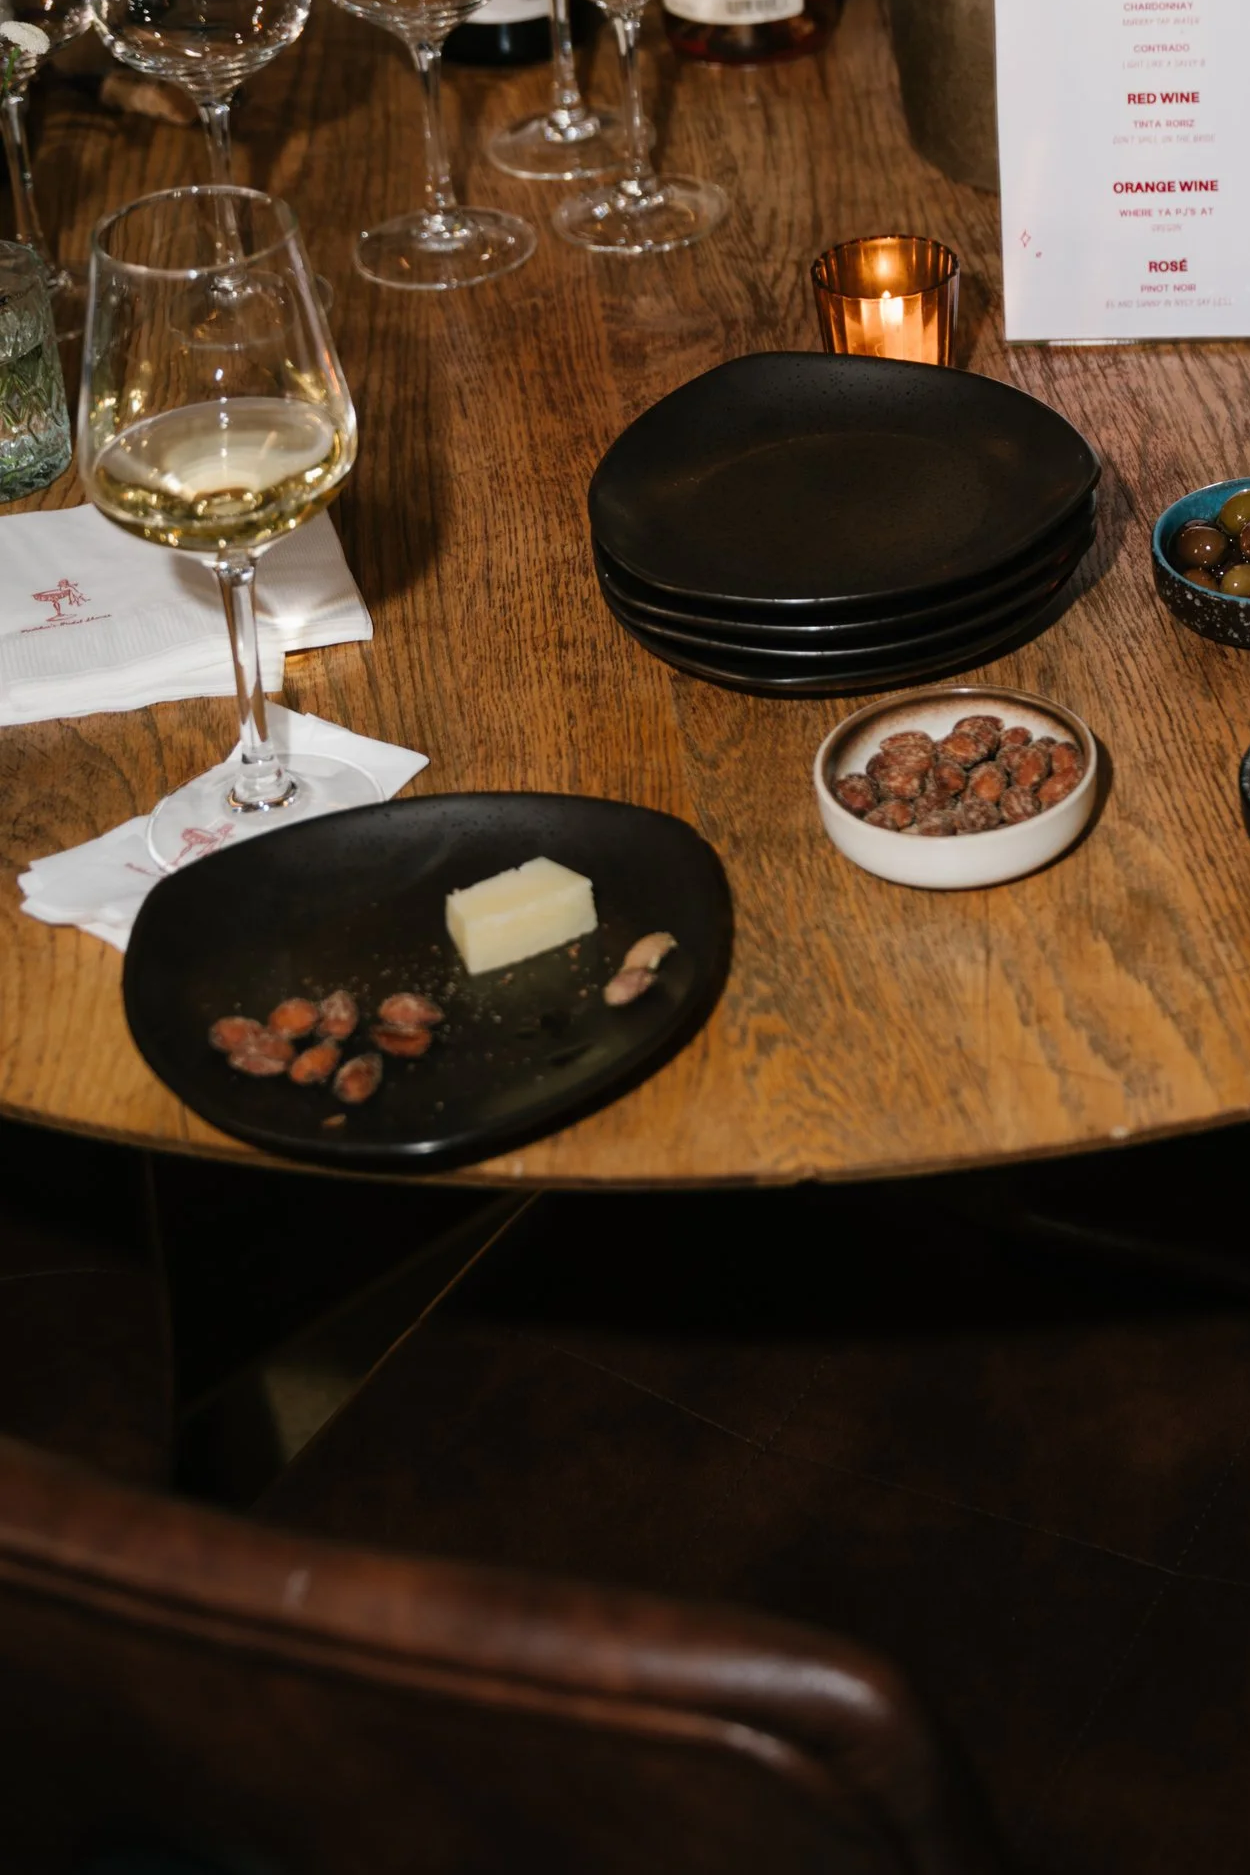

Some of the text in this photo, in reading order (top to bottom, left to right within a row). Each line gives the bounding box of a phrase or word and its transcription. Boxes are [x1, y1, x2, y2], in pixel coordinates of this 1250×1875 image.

[1123, 2, 1193, 11] CHARDONNAY
[1128, 92, 1200, 105] RED WINE
[1133, 120, 1161, 128] TINTA
[1113, 180, 1218, 194] ORANGE WINE
[1119, 208, 1153, 218] WHERE
[1200, 207, 1214, 216] AT
[1149, 258, 1188, 273] ROSÉ
[1140, 284, 1196, 293] PINOT NOIR
